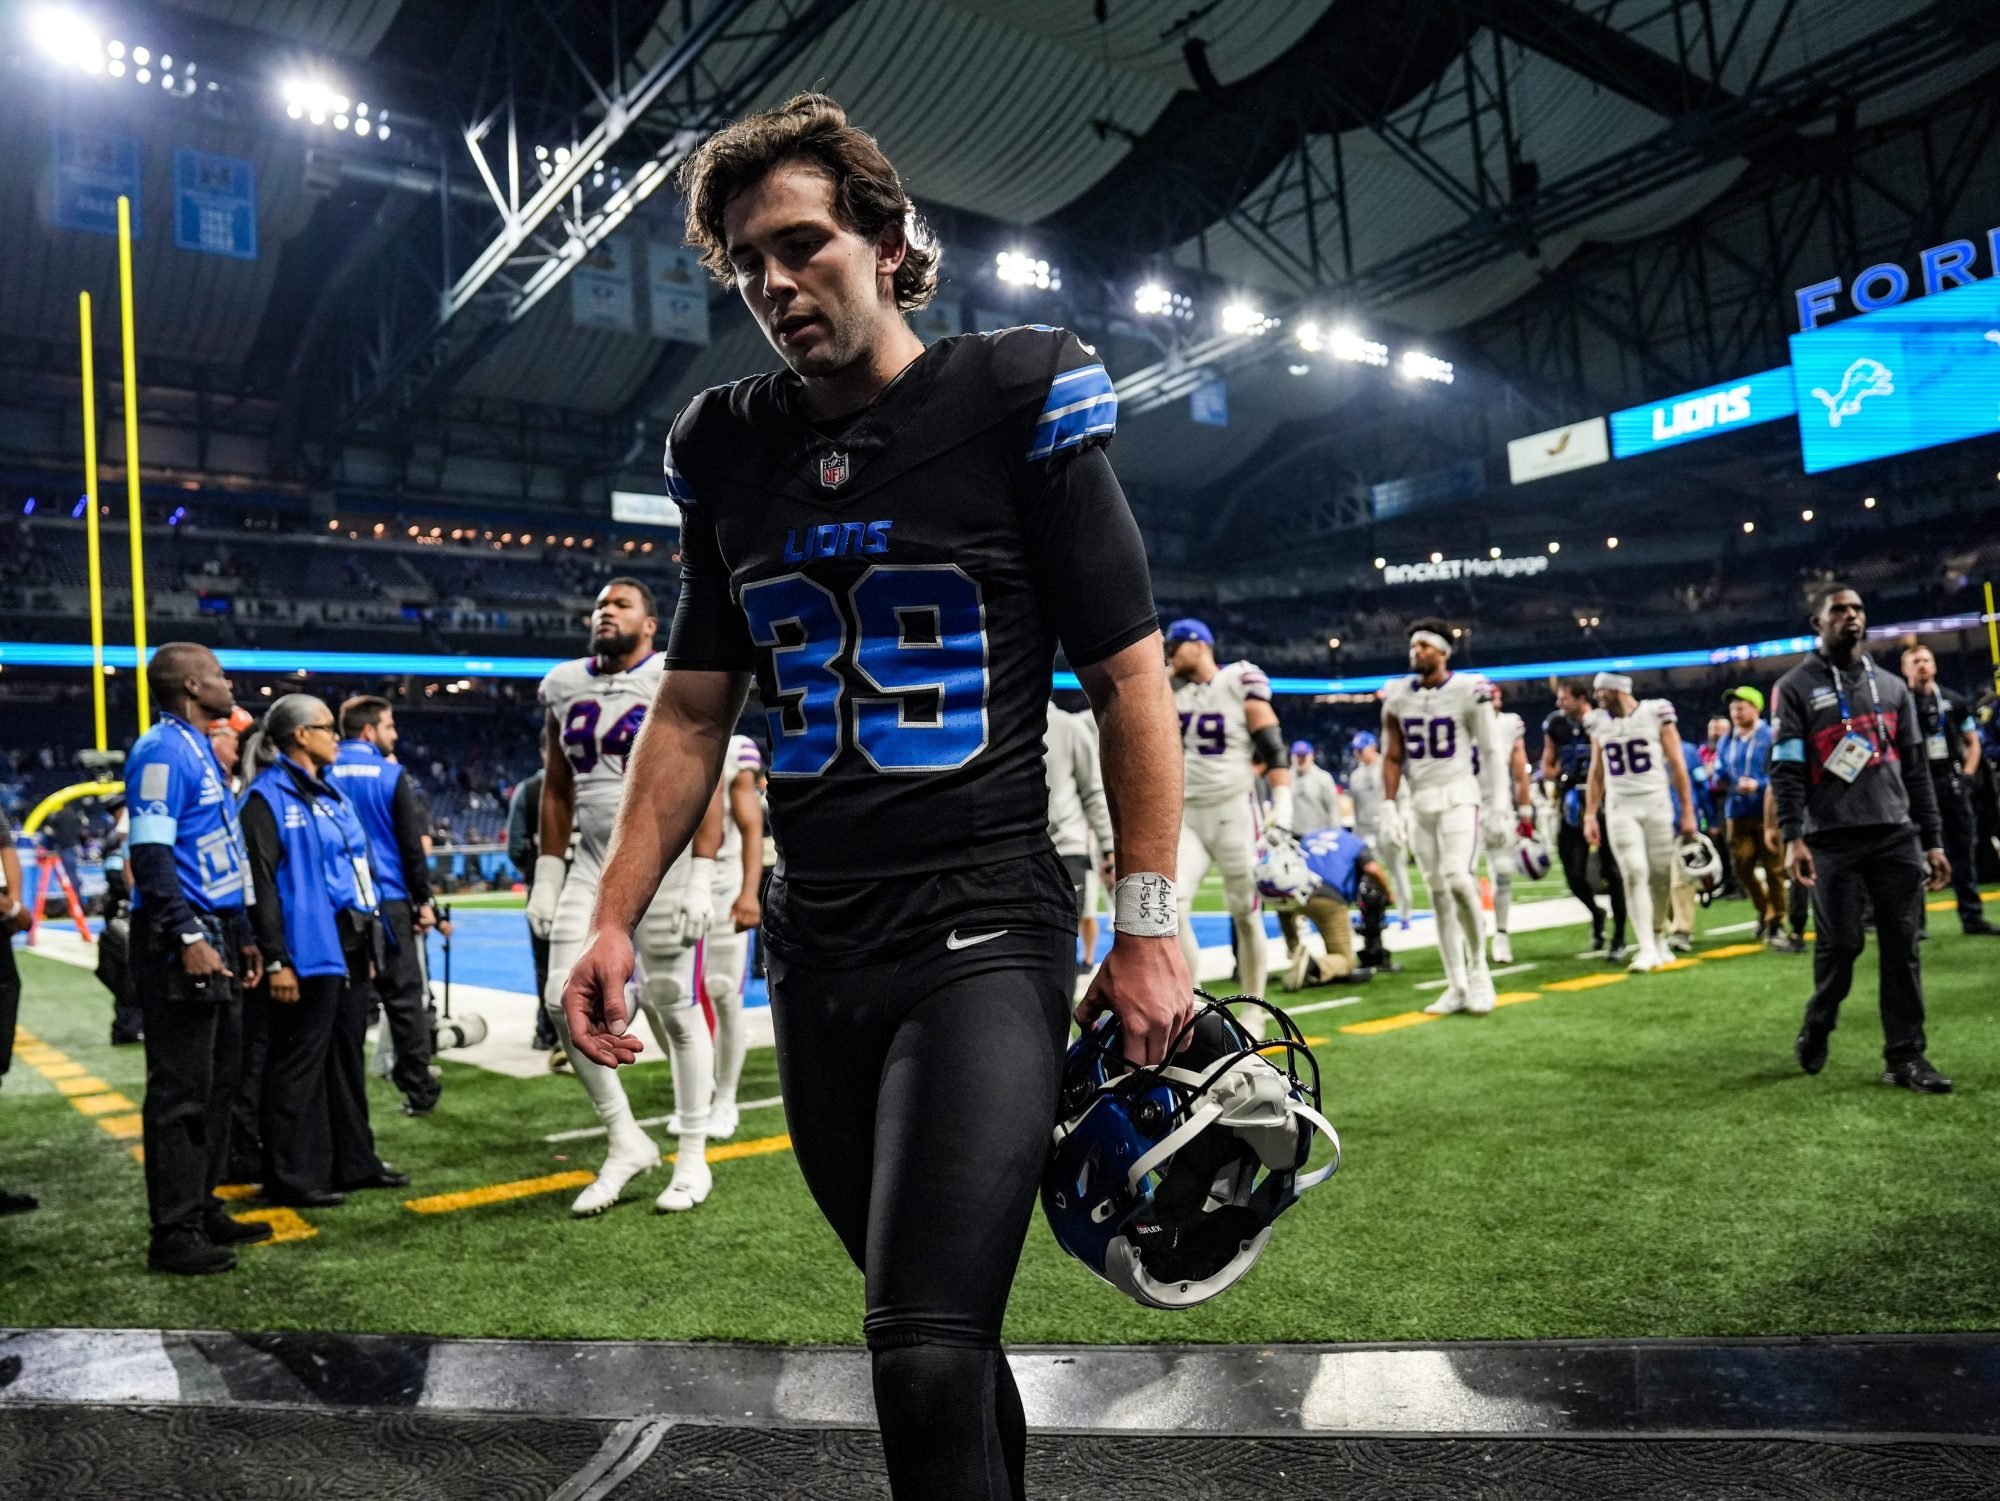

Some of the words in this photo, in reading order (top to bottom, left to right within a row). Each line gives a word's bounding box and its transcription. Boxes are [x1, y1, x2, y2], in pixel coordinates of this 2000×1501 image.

[1652, 385, 1751, 441] LIONS
[825, 467, 844, 482] NFL
[784, 521, 893, 564] LIONS
[1384, 559, 1462, 585] ROCKET
[1463, 555, 1548, 578] Mortgage
[741, 564, 989, 778] 39
[563, 699, 647, 774] 94
[1403, 717, 1455, 759] 50
[1605, 738, 1651, 776] 86
[1140, 876, 1157, 919] Jesus
